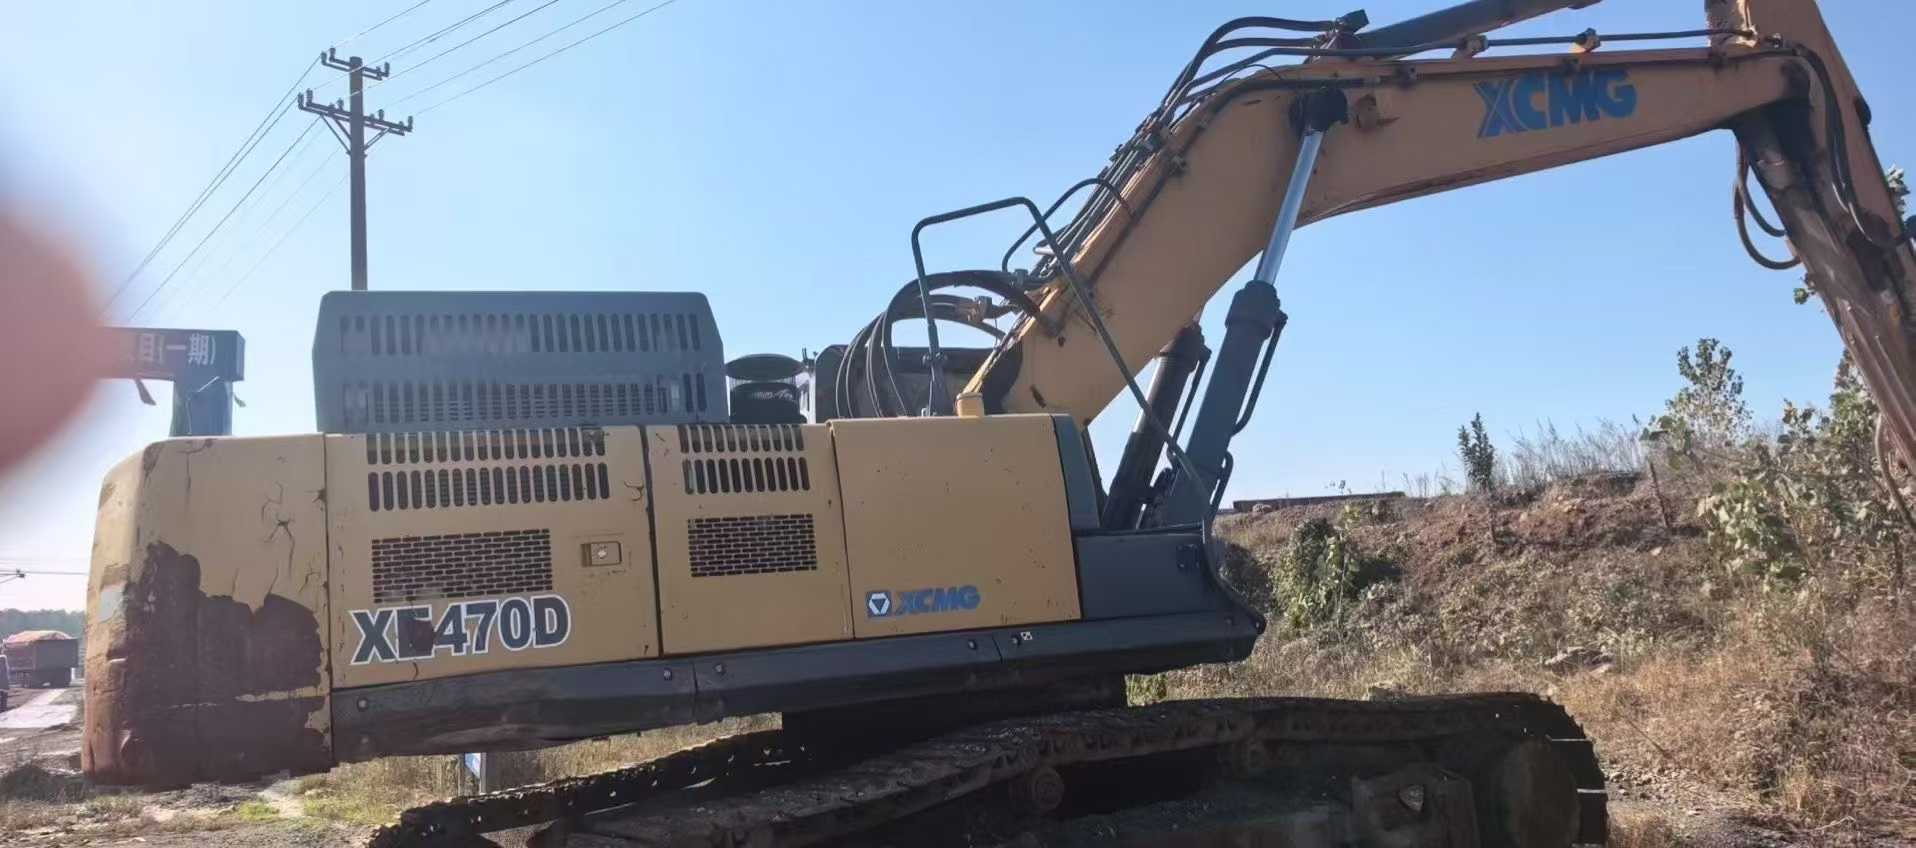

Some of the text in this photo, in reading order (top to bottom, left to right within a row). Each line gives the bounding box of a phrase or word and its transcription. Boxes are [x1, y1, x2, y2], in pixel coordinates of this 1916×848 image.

[1474, 69, 1638, 137] XCMG
[127, 333, 217, 366] 目(一期)
[897, 585, 981, 615] XCMG
